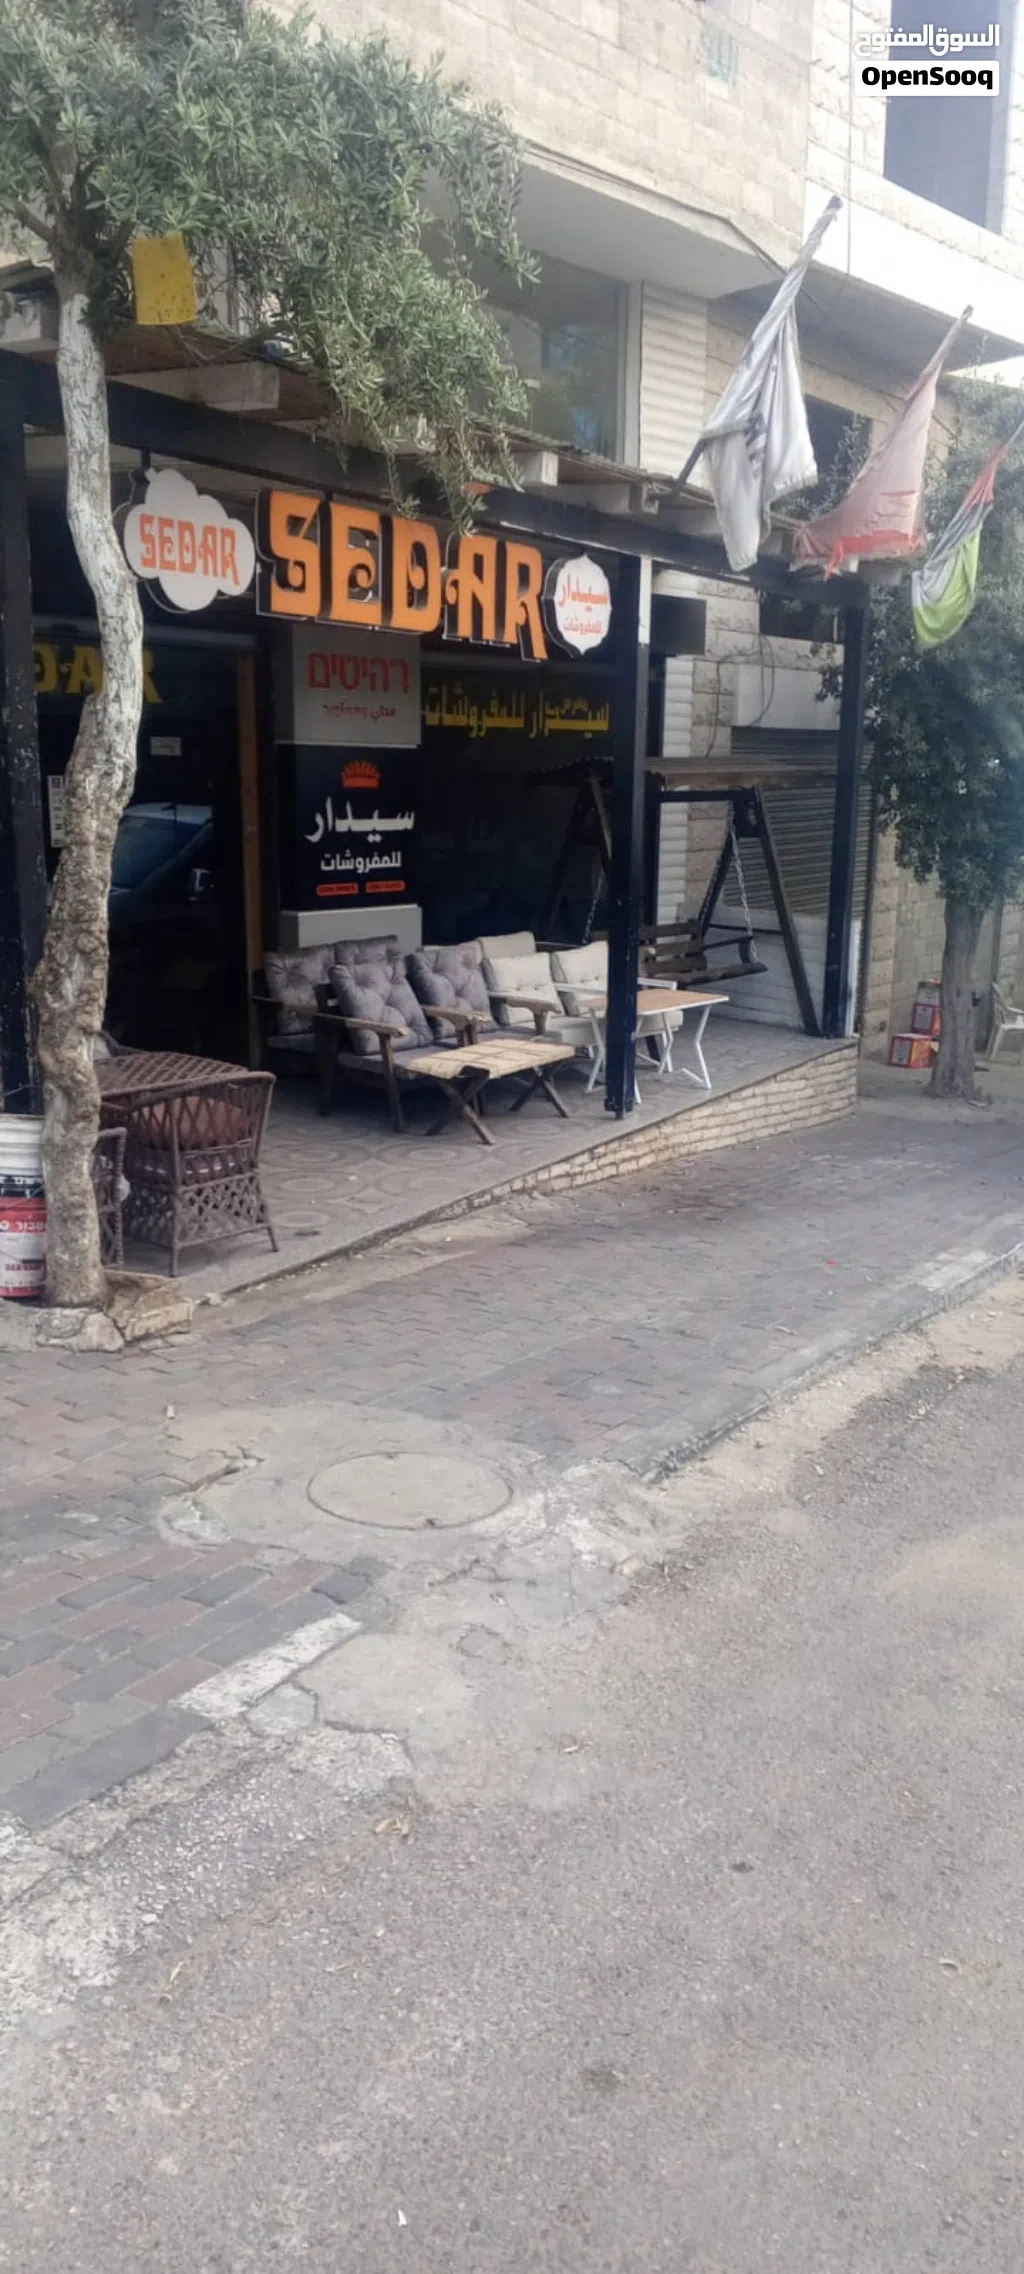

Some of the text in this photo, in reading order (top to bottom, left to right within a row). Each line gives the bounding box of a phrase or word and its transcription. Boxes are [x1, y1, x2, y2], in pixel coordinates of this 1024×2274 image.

[138, 513, 240, 586] SEDAR
[269, 489, 548, 660] SEDAR
[558, 572, 609, 612] سيدار
[307, 653, 411, 694] רהיטים
[304, 795, 416, 844] سيدار
[320, 849, 402, 874] للمفروشات
